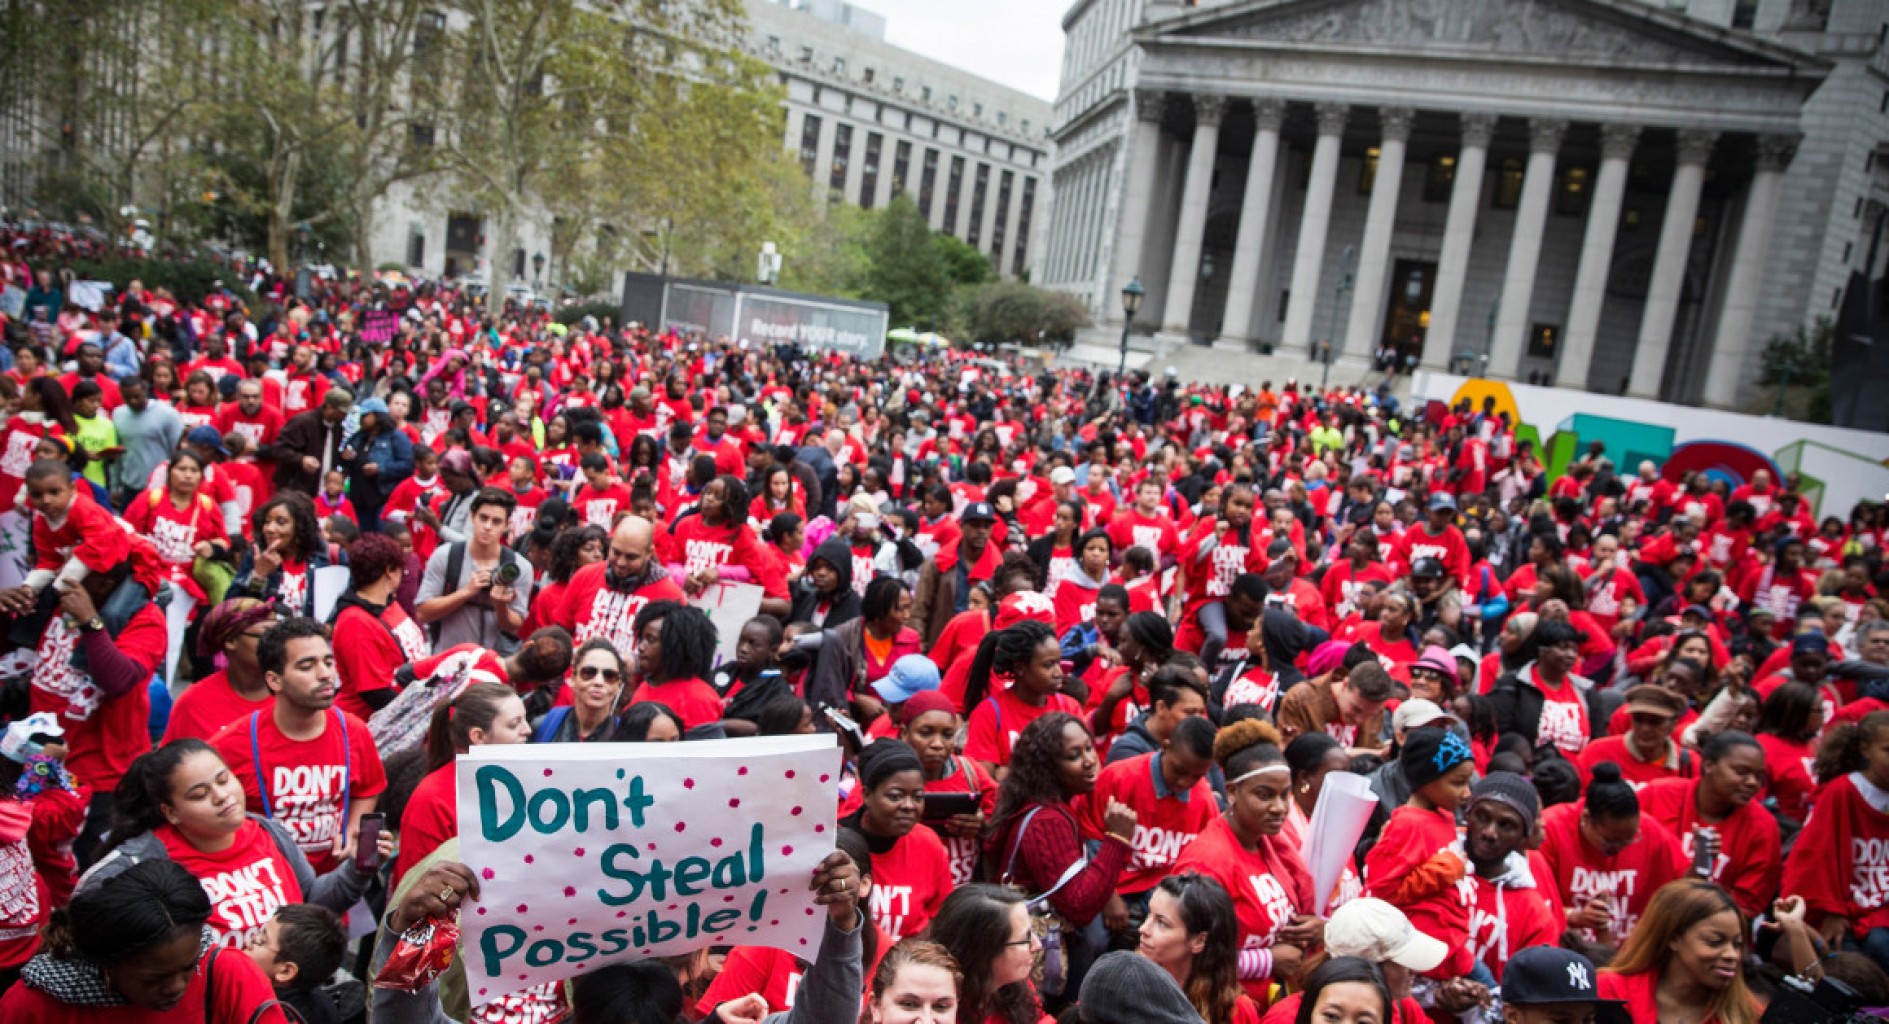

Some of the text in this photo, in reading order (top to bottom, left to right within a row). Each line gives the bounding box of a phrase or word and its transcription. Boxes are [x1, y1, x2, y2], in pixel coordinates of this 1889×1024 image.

[751, 318, 797, 340] Record
[799, 324, 836, 343] YOUR
[685, 539, 733, 566] DON'T
[273, 764, 347, 797] DON'T
[475, 765, 654, 842] Don't
[199, 857, 282, 905] DON'T
[597, 822, 765, 906] Steal
[1570, 865, 1638, 897] DON'T
[217, 884, 288, 929] STEAL
[868, 883, 913, 916] N'T
[479, 888, 768, 977] Possible!
